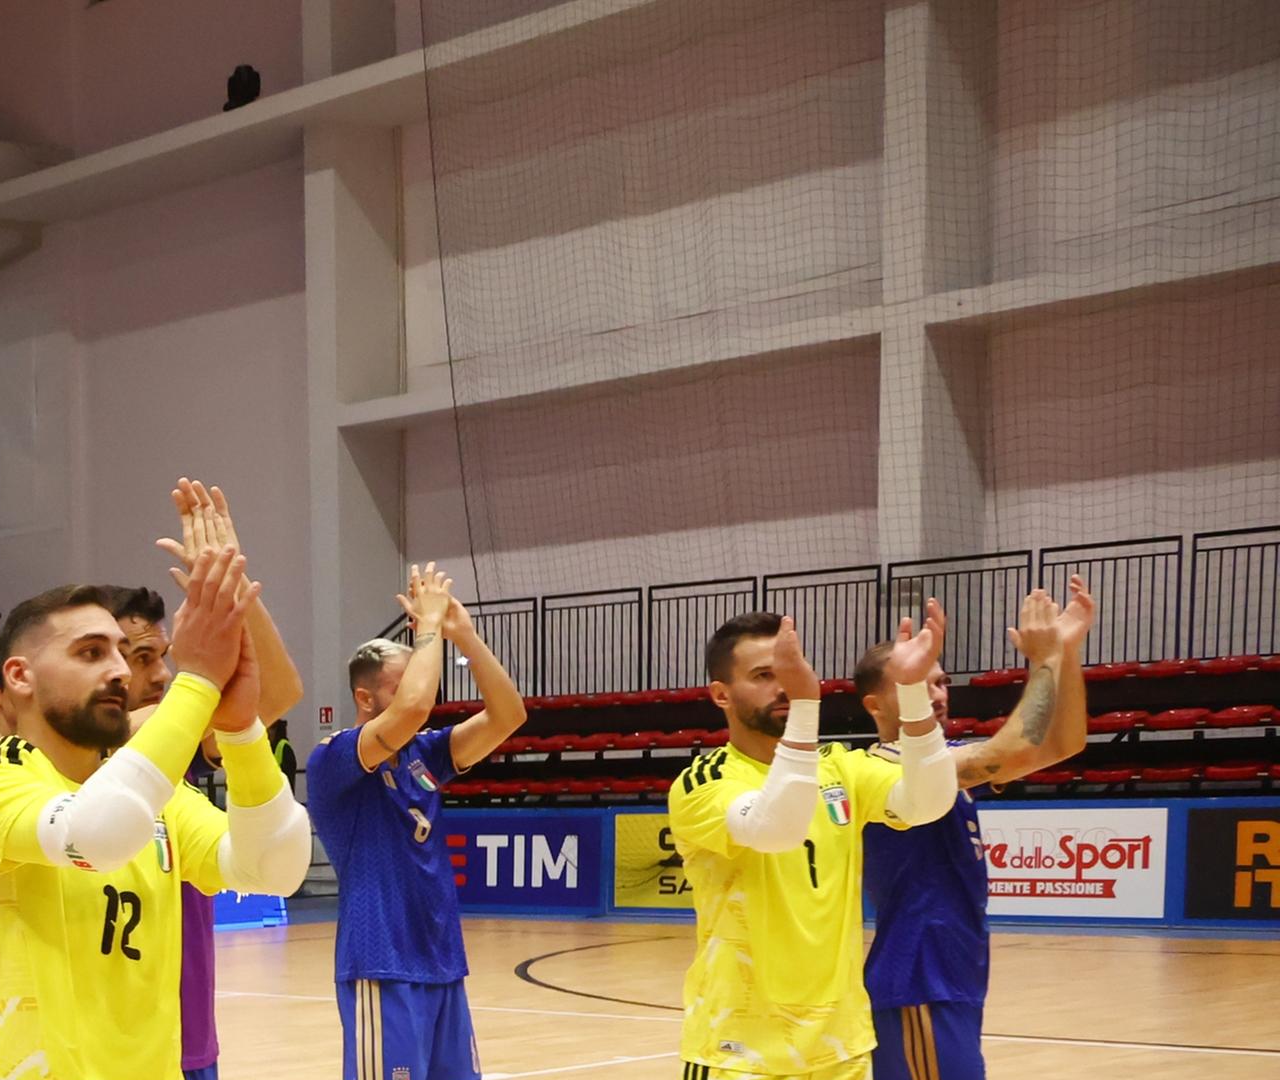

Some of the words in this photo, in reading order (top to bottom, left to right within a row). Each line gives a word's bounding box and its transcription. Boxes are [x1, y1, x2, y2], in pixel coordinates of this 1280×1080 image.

[476, 835, 578, 888] TIM
[803, 839, 818, 889] 1
[1010, 846, 1055, 869] dello
[1057, 835, 1152, 880] Sport
[1036, 882, 1104, 895] PASSIONE
[101, 884, 142, 961] 12
